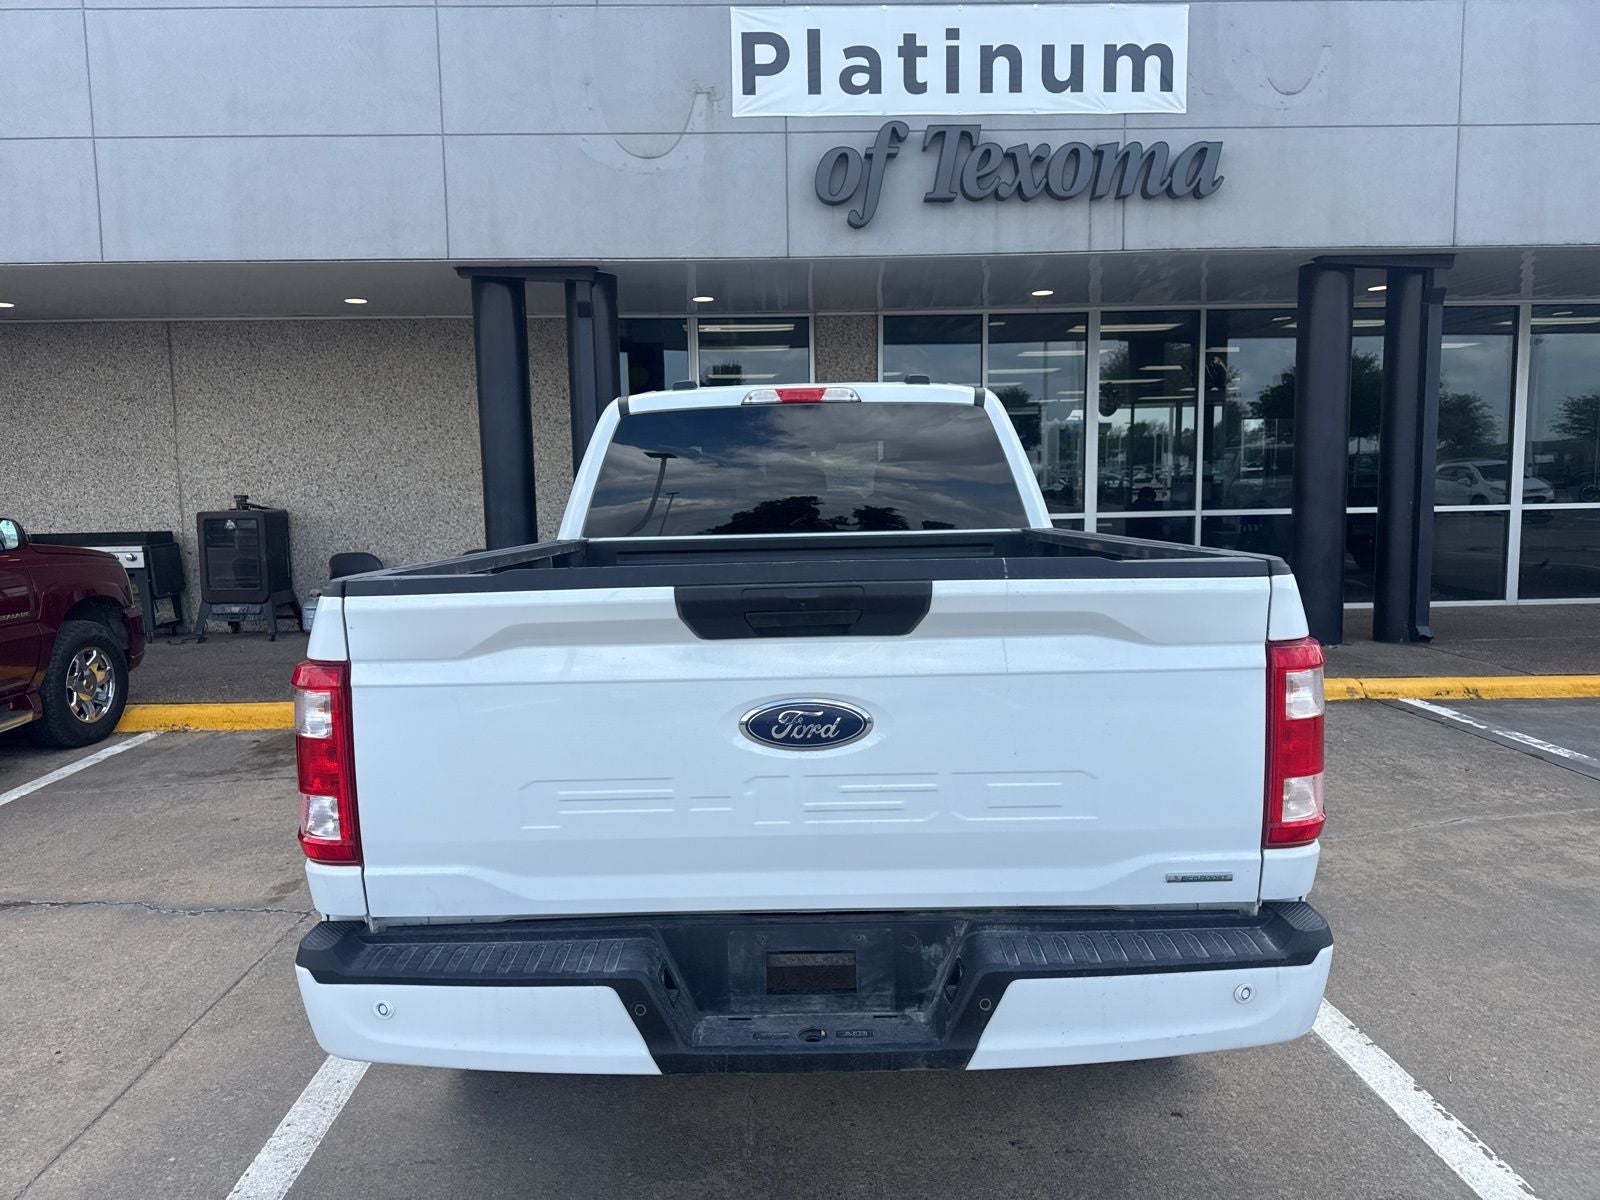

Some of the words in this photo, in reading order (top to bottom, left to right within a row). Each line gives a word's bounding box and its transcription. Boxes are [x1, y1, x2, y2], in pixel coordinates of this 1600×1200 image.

[740, 28, 1174, 96] Platinum
[815, 120, 909, 229] of
[922, 124, 1224, 202] Texoma
[771, 710, 841, 739] Ford
